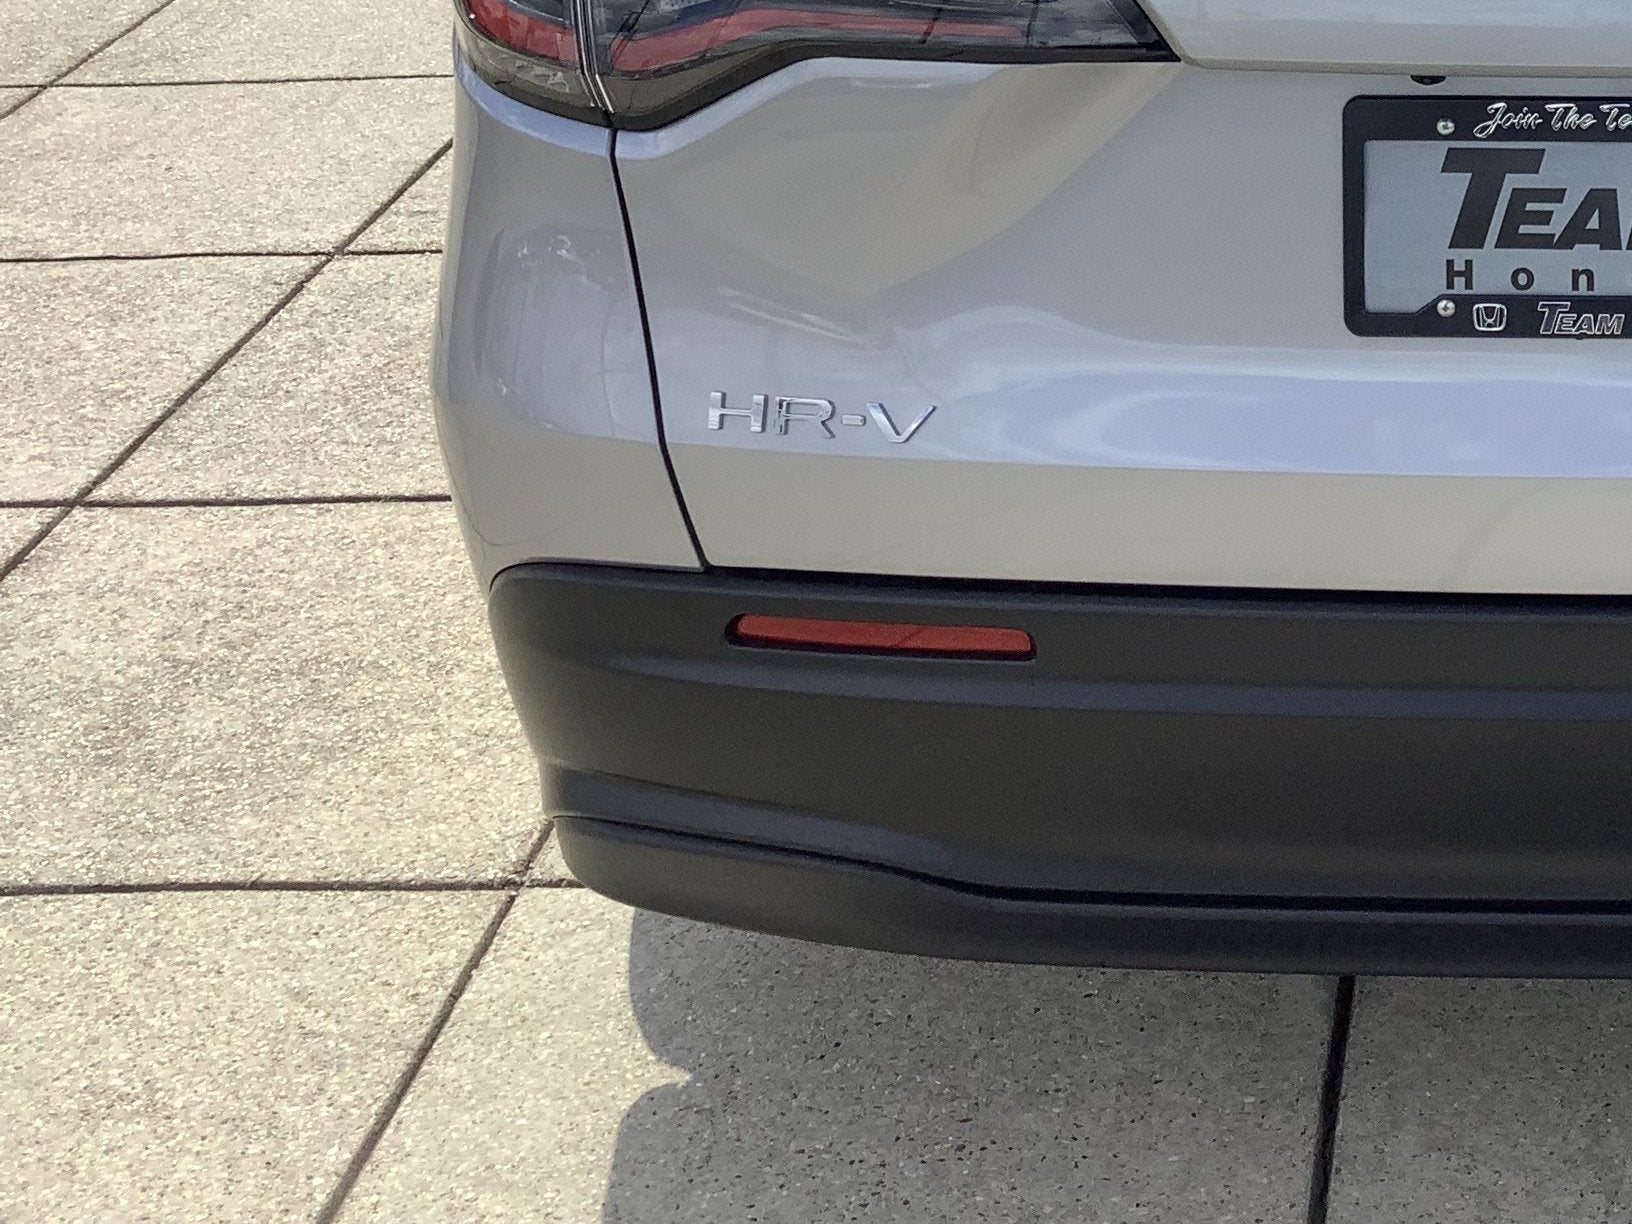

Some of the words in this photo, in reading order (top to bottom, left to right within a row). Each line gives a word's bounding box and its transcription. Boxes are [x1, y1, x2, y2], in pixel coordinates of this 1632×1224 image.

[1473, 102, 1543, 139] Join
[1545, 103, 1597, 131] The
[1537, 301, 1625, 335] TEAM
[707, 391, 937, 444] HR-V
